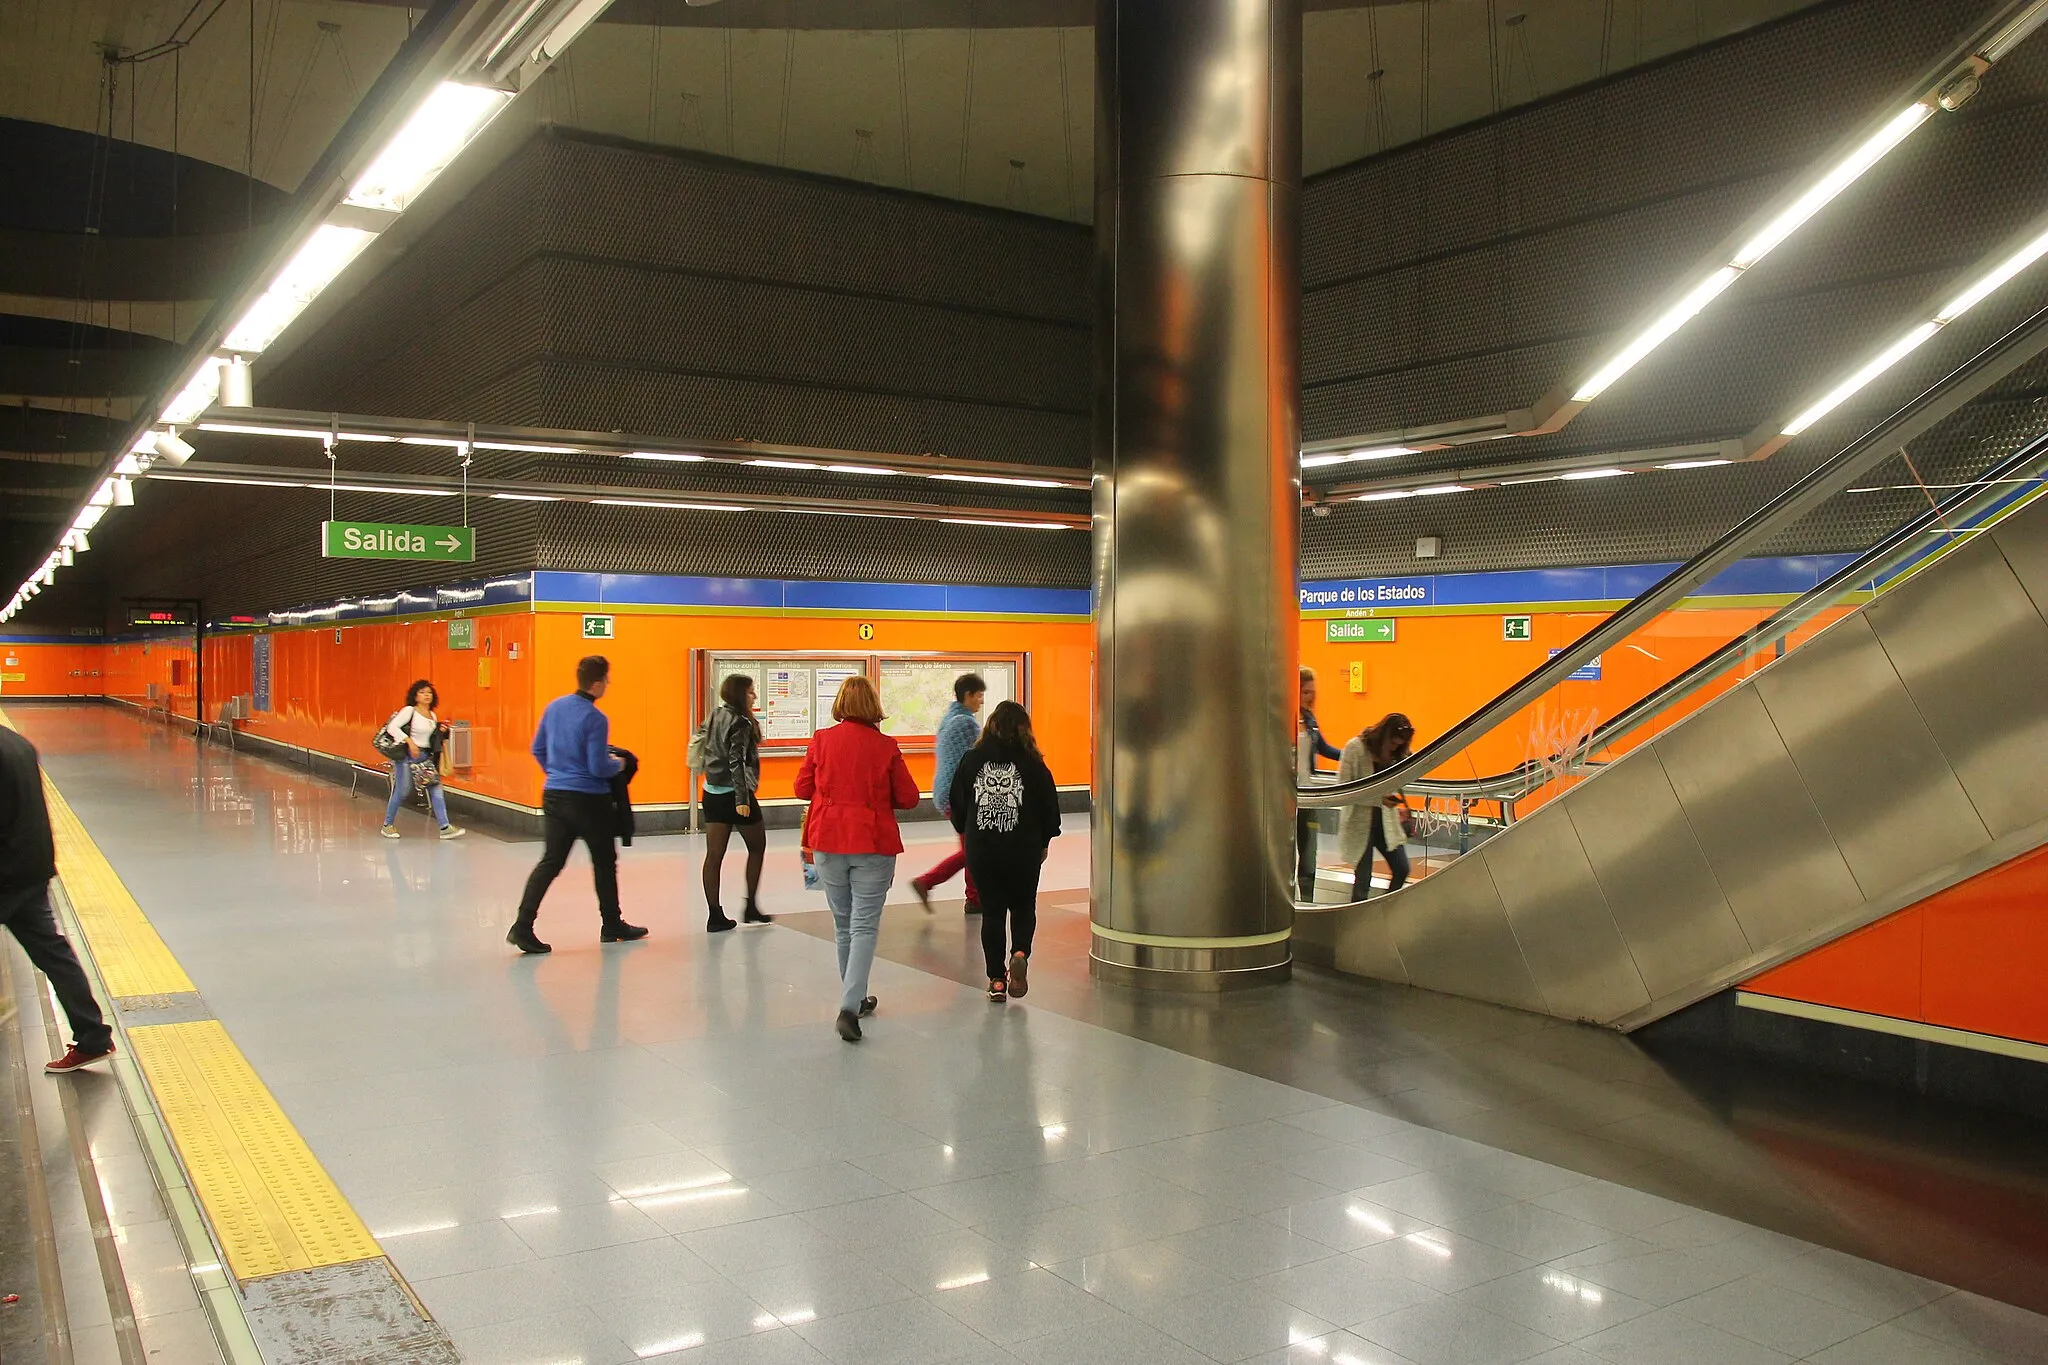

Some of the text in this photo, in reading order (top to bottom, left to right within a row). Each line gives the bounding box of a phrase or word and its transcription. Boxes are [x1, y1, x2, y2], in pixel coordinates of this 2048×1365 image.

[343, 527, 426, 553] Salida
[1300, 585, 1425, 606] Parque de los Estados
[1346, 609, 1367, 617] Andén
[1329, 623, 1365, 637] Salida
[904, 662, 923, 670] Plano
